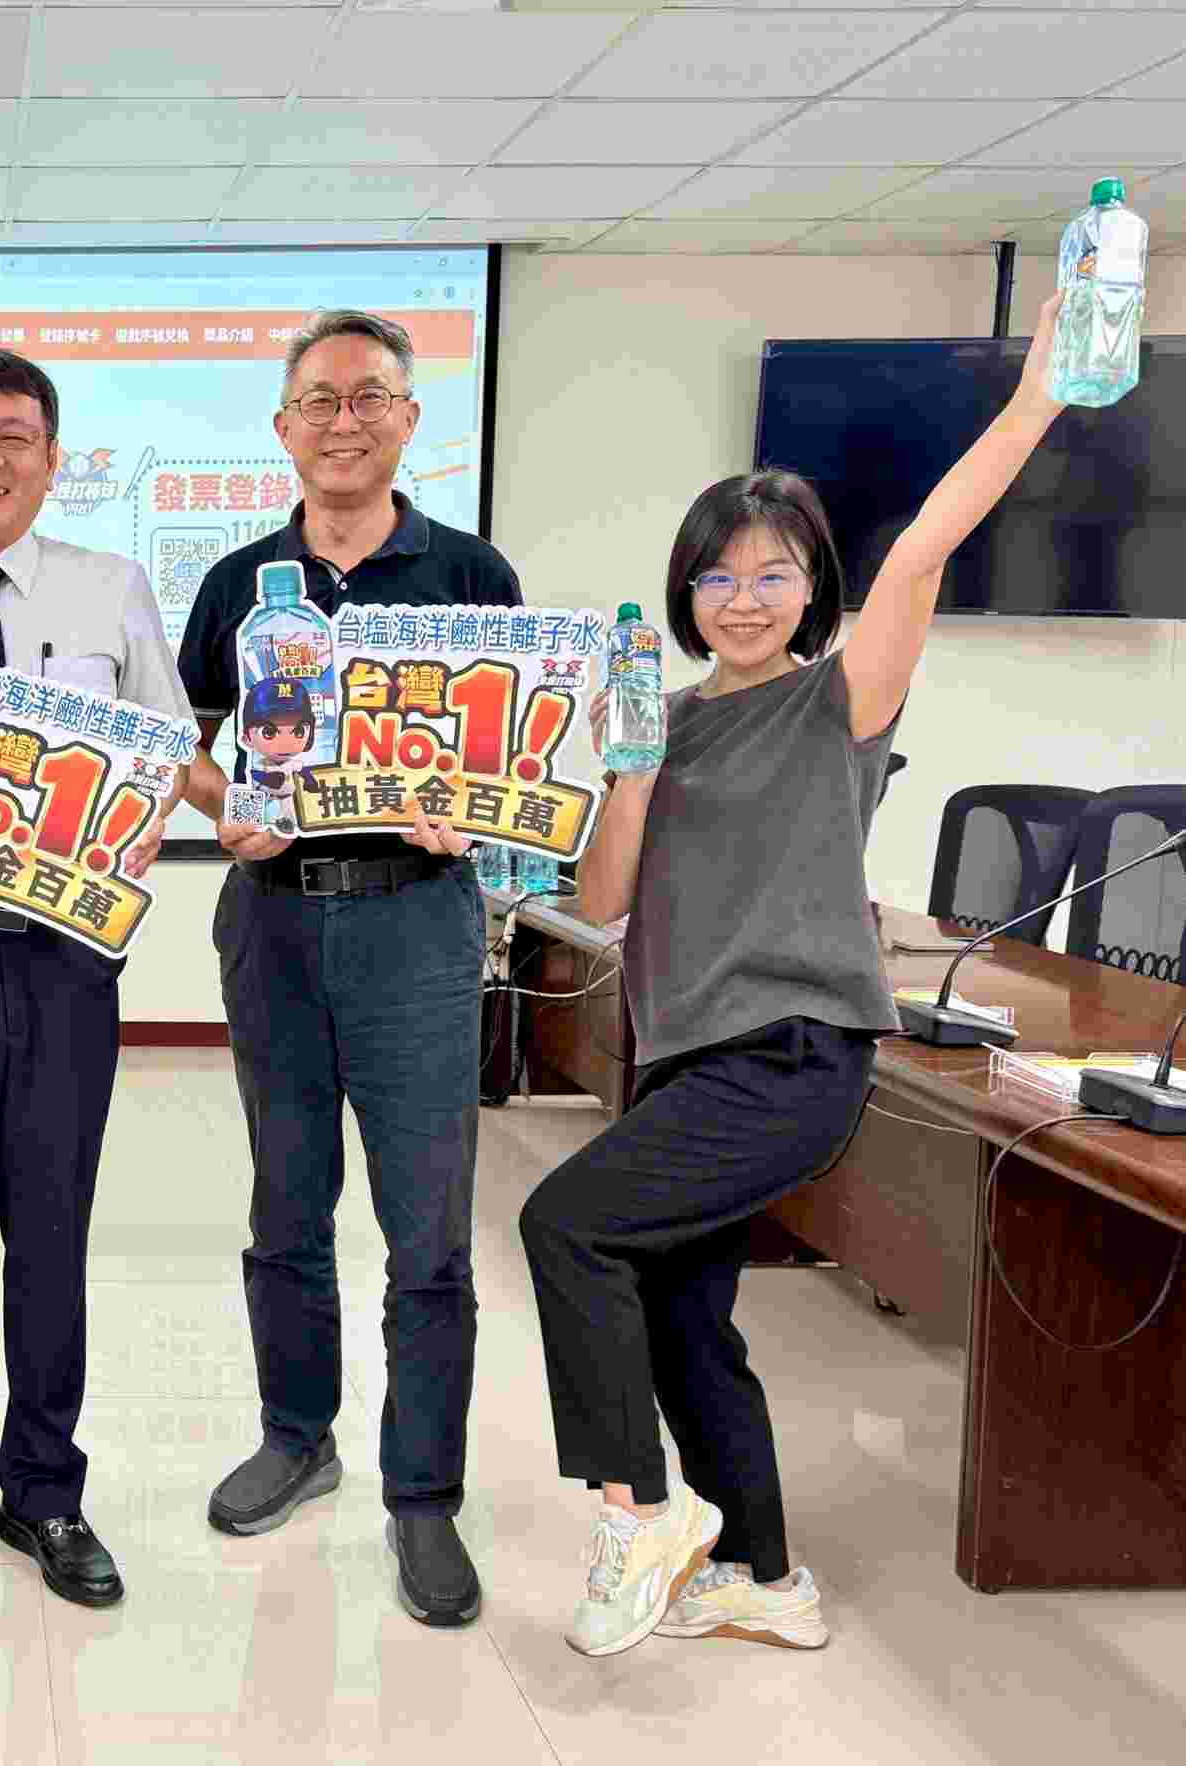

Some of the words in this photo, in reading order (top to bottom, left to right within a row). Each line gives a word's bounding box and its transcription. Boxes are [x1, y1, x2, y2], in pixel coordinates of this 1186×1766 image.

[156, 473, 298, 511] 發票登錄
[338, 614, 601, 653] 台塩海洋鹼性離子水
[344, 660, 447, 714] 台灣
[316, 774, 565, 839] 抽黃金百萬
